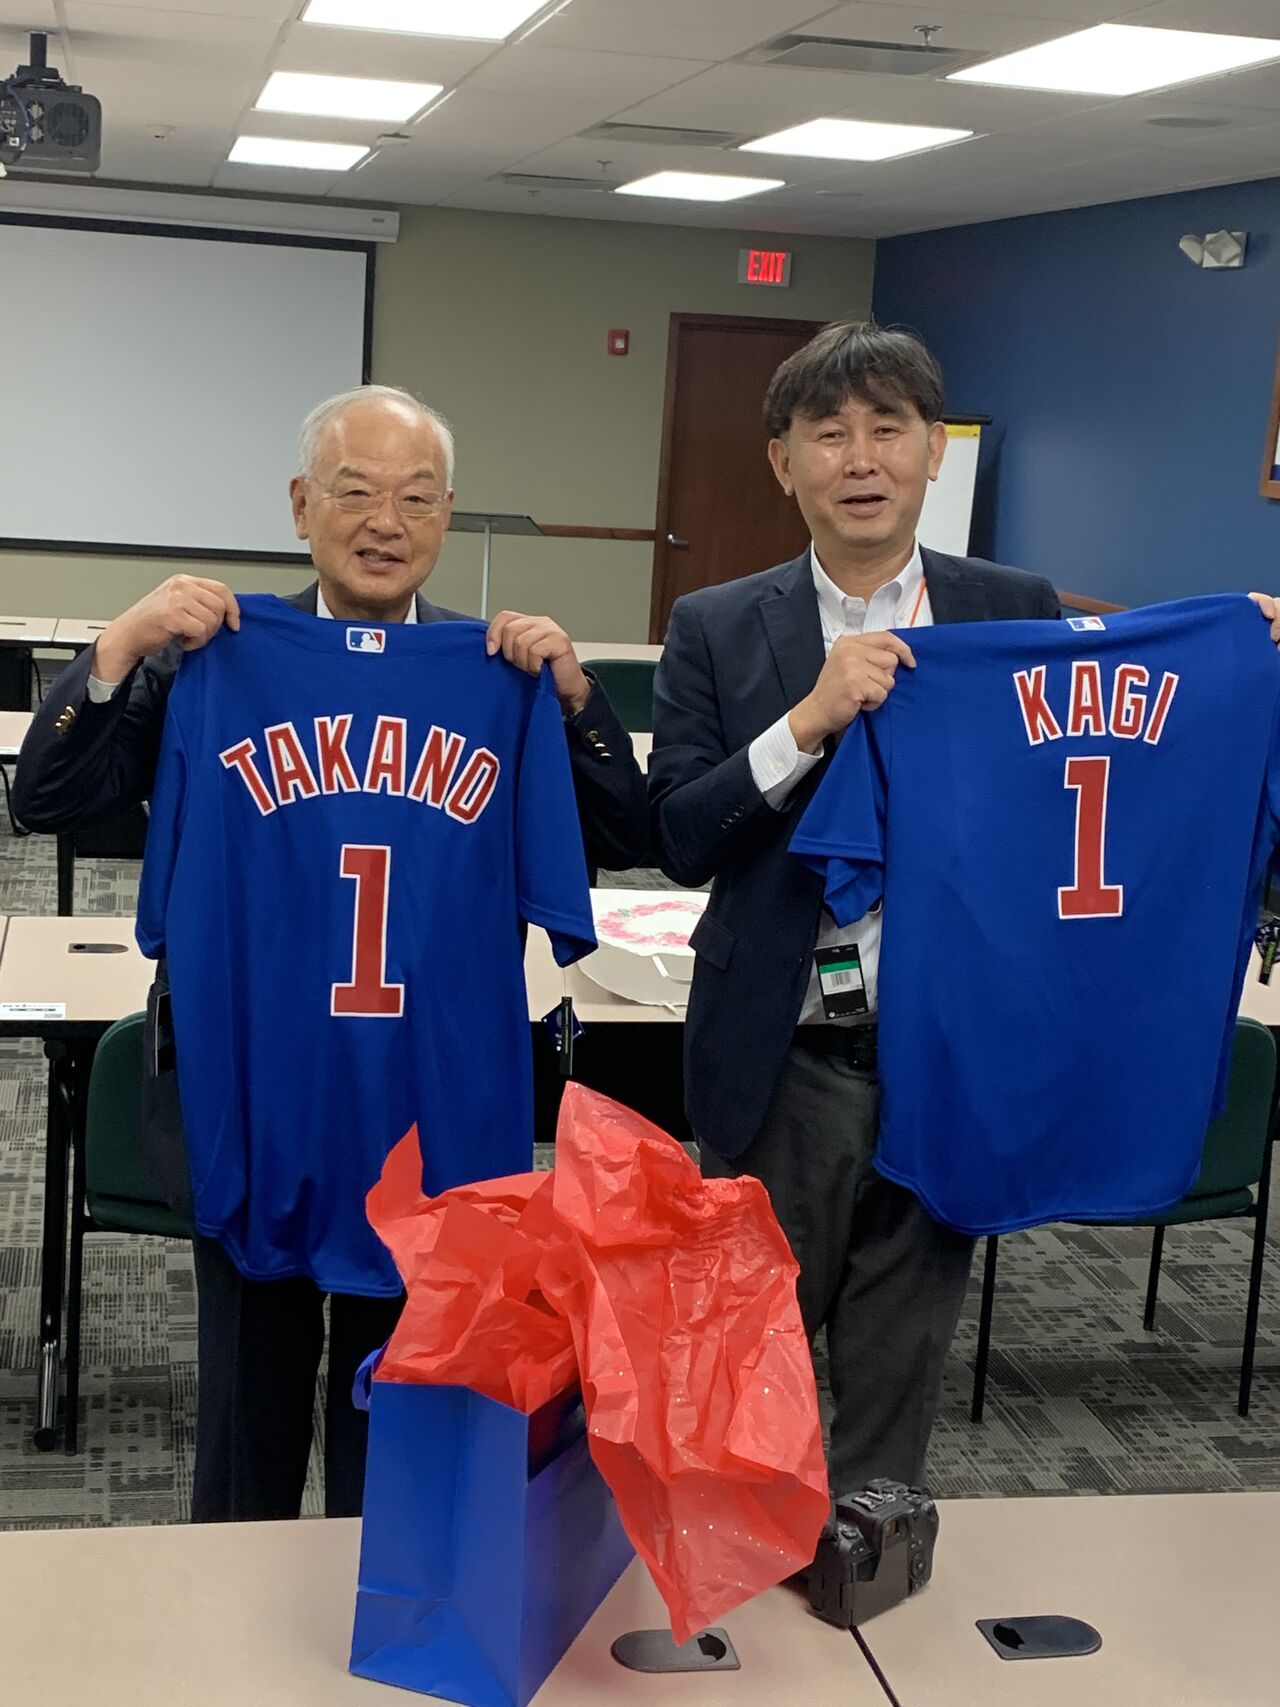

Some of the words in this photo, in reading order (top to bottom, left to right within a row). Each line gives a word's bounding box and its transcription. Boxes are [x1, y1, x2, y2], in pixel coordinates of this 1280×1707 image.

[747, 250, 787, 282] EXIT
[1013, 661, 1179, 746] KAGI
[219, 714, 500, 824] TAKANO
[1058, 756, 1123, 919] 1
[330, 844, 404, 1018] 1
